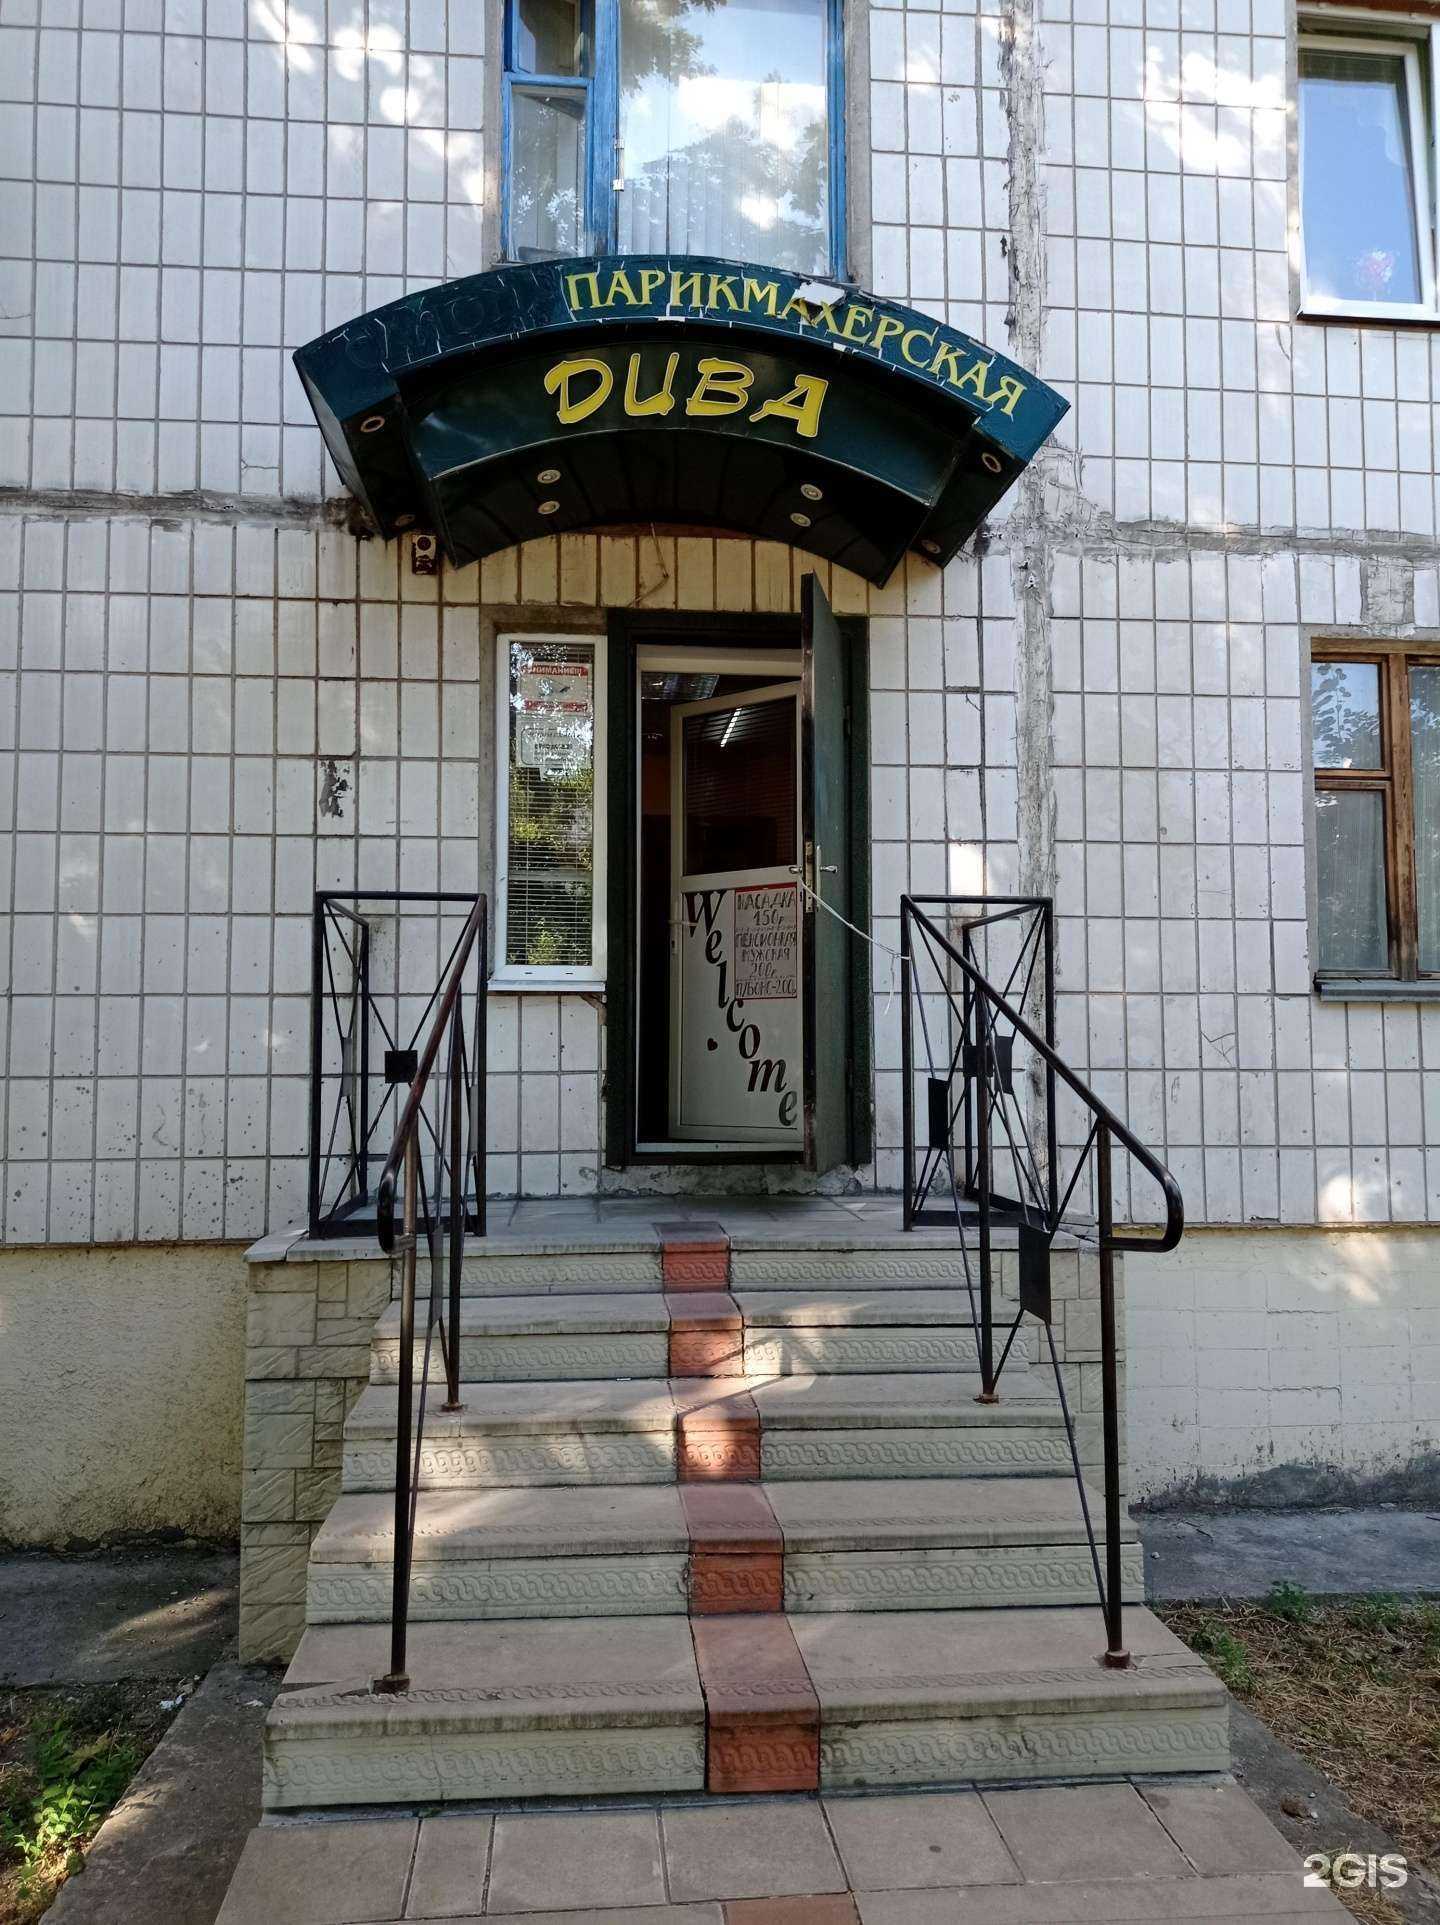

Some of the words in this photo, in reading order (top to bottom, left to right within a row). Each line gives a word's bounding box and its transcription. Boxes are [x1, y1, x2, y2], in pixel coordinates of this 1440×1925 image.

[562, 268, 1028, 417] ПАРИКМАХЕРСКАЯ
[736, 891, 796, 911] НАСАДКА
[741, 947, 790, 962] МУЖСКАЯ
[684, 889, 798, 1127] Welcome
